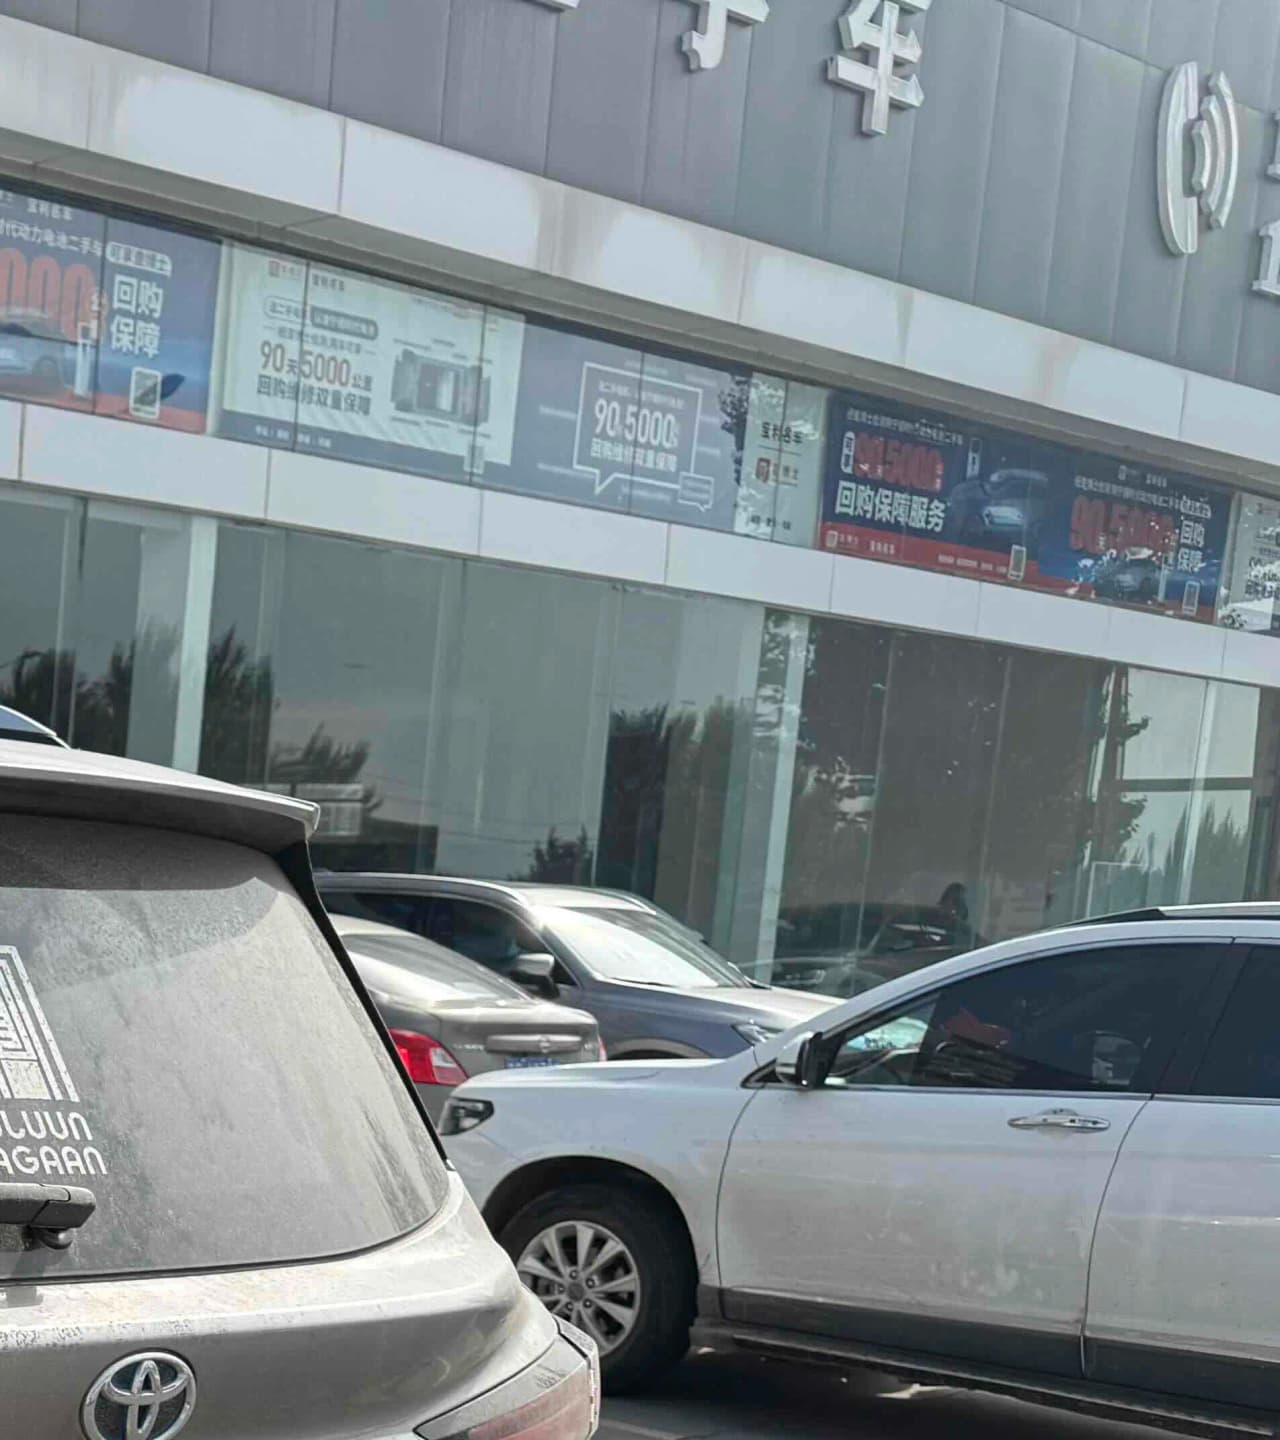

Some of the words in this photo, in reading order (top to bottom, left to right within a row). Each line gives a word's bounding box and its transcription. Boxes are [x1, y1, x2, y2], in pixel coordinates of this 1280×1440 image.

[112, 273, 164, 319] 回购
[110, 314, 161, 359] 保障
[835, 479, 946, 532] 回购保障服务
